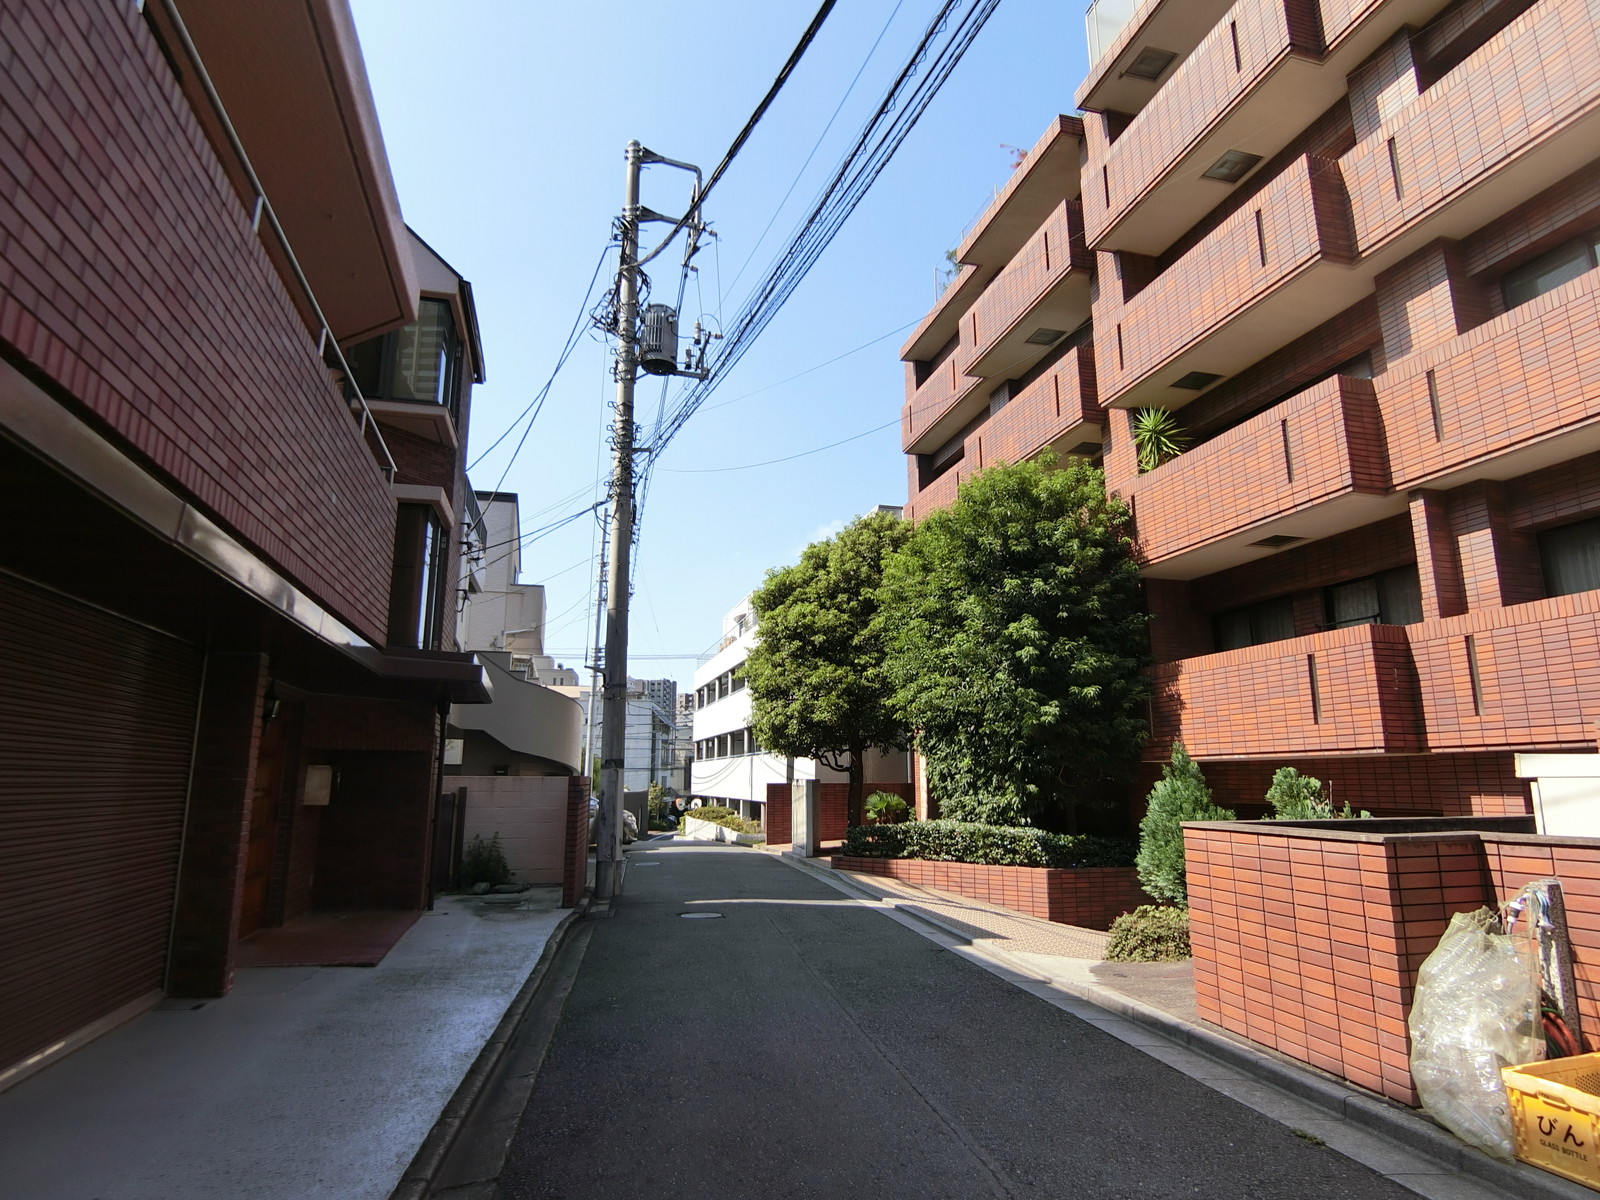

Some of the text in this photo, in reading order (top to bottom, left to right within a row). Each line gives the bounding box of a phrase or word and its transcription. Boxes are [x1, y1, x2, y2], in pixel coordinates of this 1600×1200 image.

[1537, 1116, 1584, 1147] びん
[1540, 1139, 1588, 1161] GLASS BOTTLE
